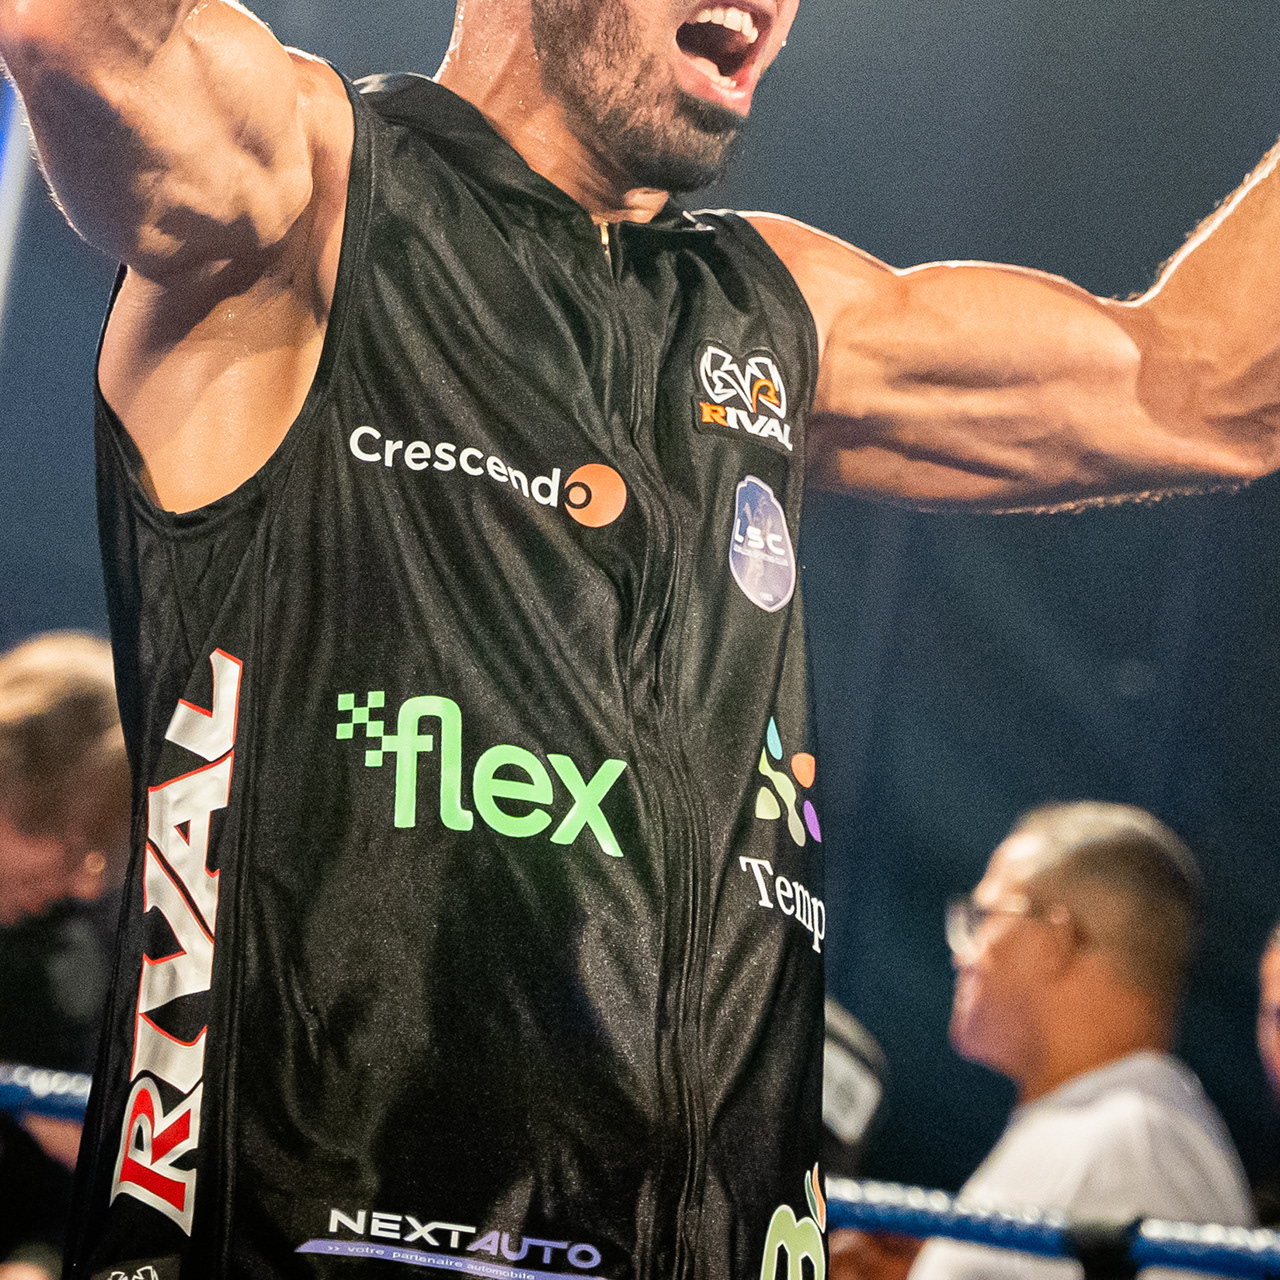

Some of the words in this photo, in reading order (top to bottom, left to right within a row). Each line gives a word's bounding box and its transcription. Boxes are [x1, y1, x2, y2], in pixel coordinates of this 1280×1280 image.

[699, 401, 793, 451] RIVAL
[734, 517, 786, 556] LSC
[384, 695, 627, 857] flex
[109, 647, 243, 1237] RIVAL
[347, 1245, 386, 1256] votre
[392, 1250, 464, 1269] partenaire
[466, 1262, 536, 1280] automobile
